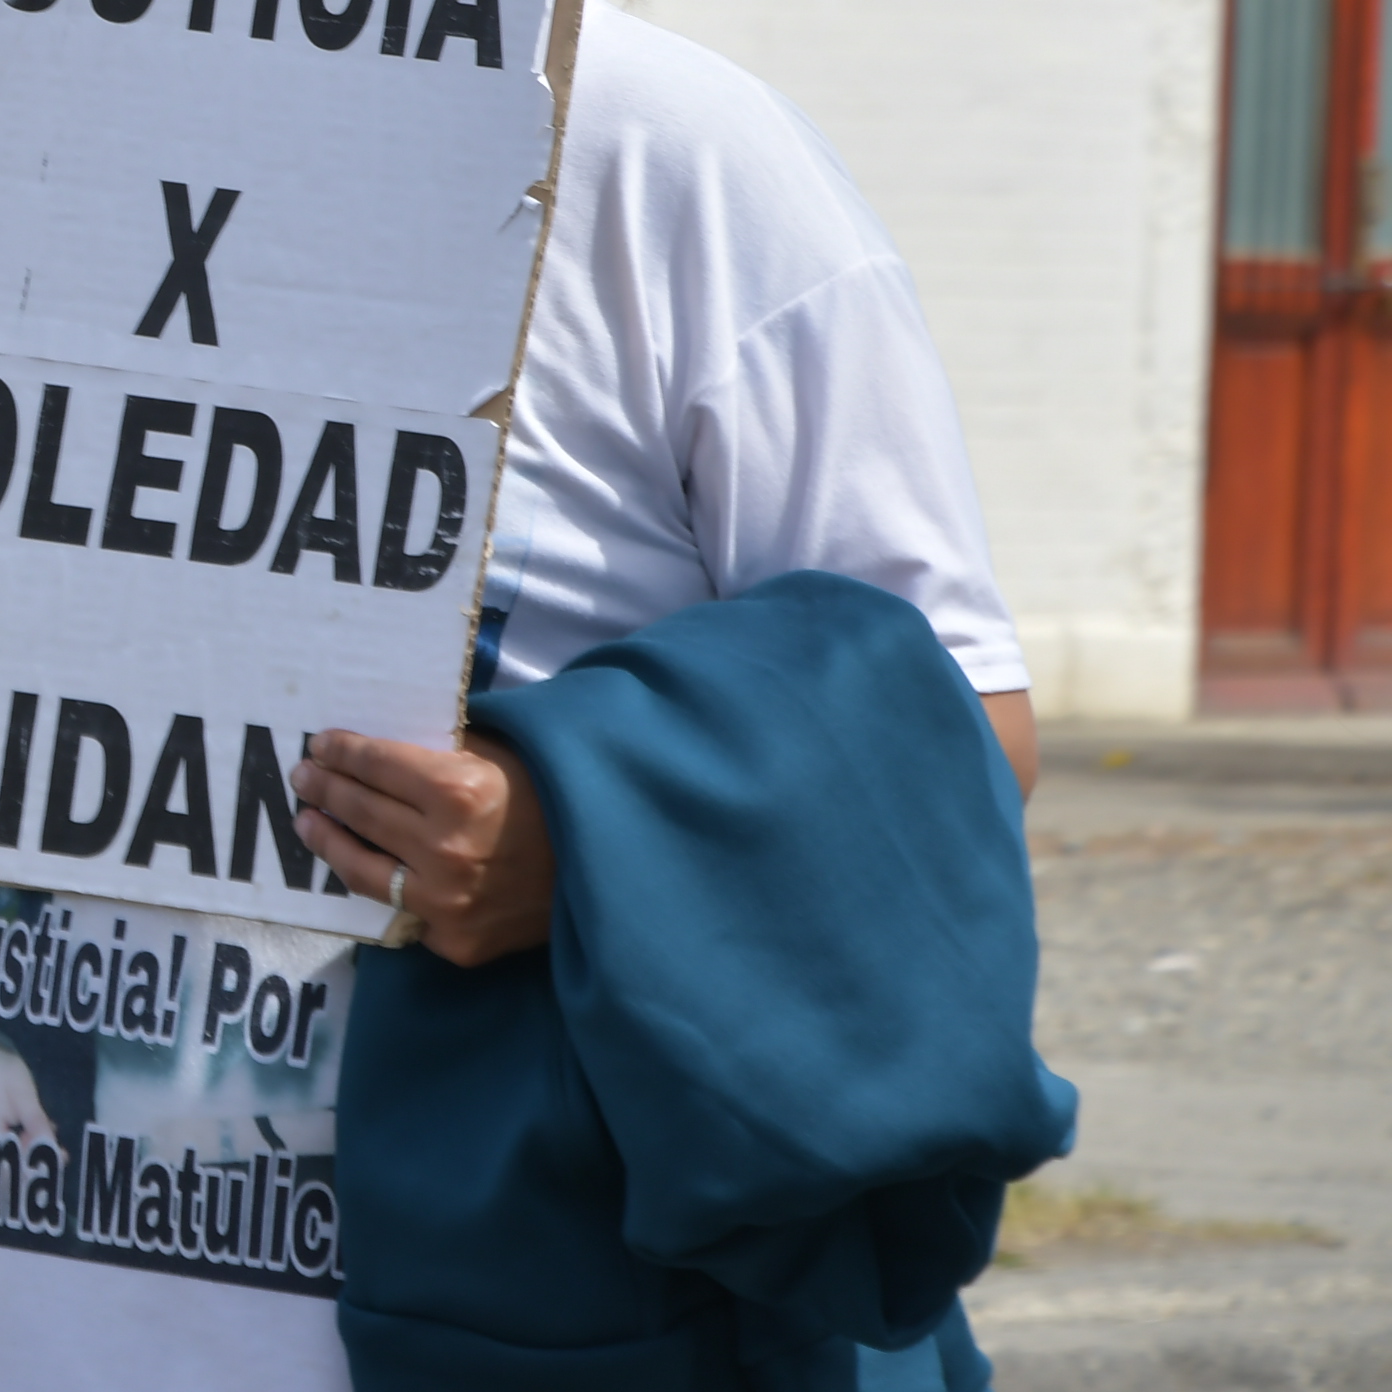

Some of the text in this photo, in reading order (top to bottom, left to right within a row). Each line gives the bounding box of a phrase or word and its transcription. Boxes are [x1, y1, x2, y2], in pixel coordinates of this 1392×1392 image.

[133, 179, 243, 348] X
[201, 941, 328, 1068] Por
[77, 1122, 346, 1280] Matulic
